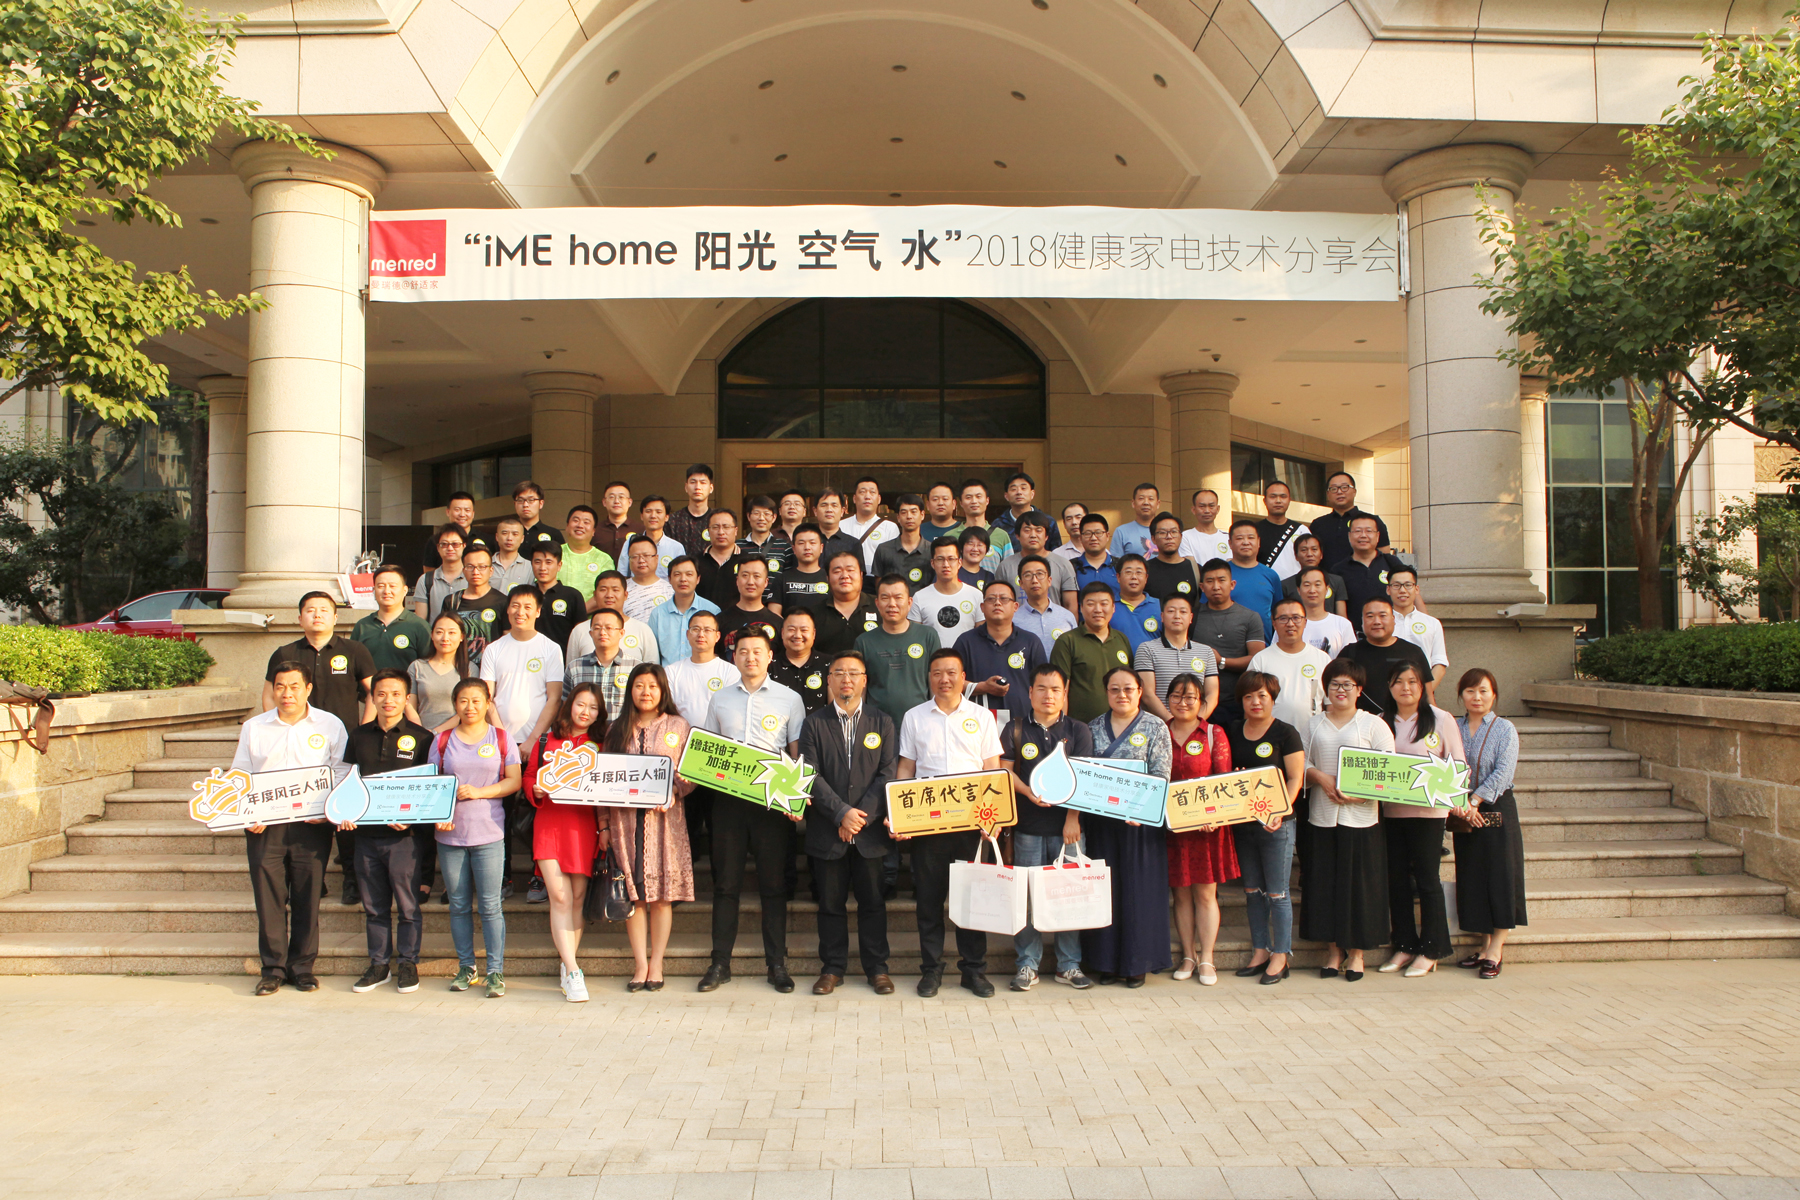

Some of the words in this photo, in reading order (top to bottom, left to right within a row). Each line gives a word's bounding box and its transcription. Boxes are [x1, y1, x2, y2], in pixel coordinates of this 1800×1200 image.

[465, 234, 551, 266] “iME
[570, 234, 677, 265] home
[696, 230, 776, 271] 阳光
[799, 230, 881, 270] 空气
[371, 253, 437, 272] menred
[690, 738, 738, 758] 撸起袖子
[1343, 756, 1390, 768] 撸起袖子
[589, 768, 667, 784] 年度风云人物
[1094, 772, 1113, 782] home
[247, 778, 329, 805] 年度风云人物
[897, 782, 1003, 809] 首席代言人
[1172, 778, 1275, 807] 首席代言人
